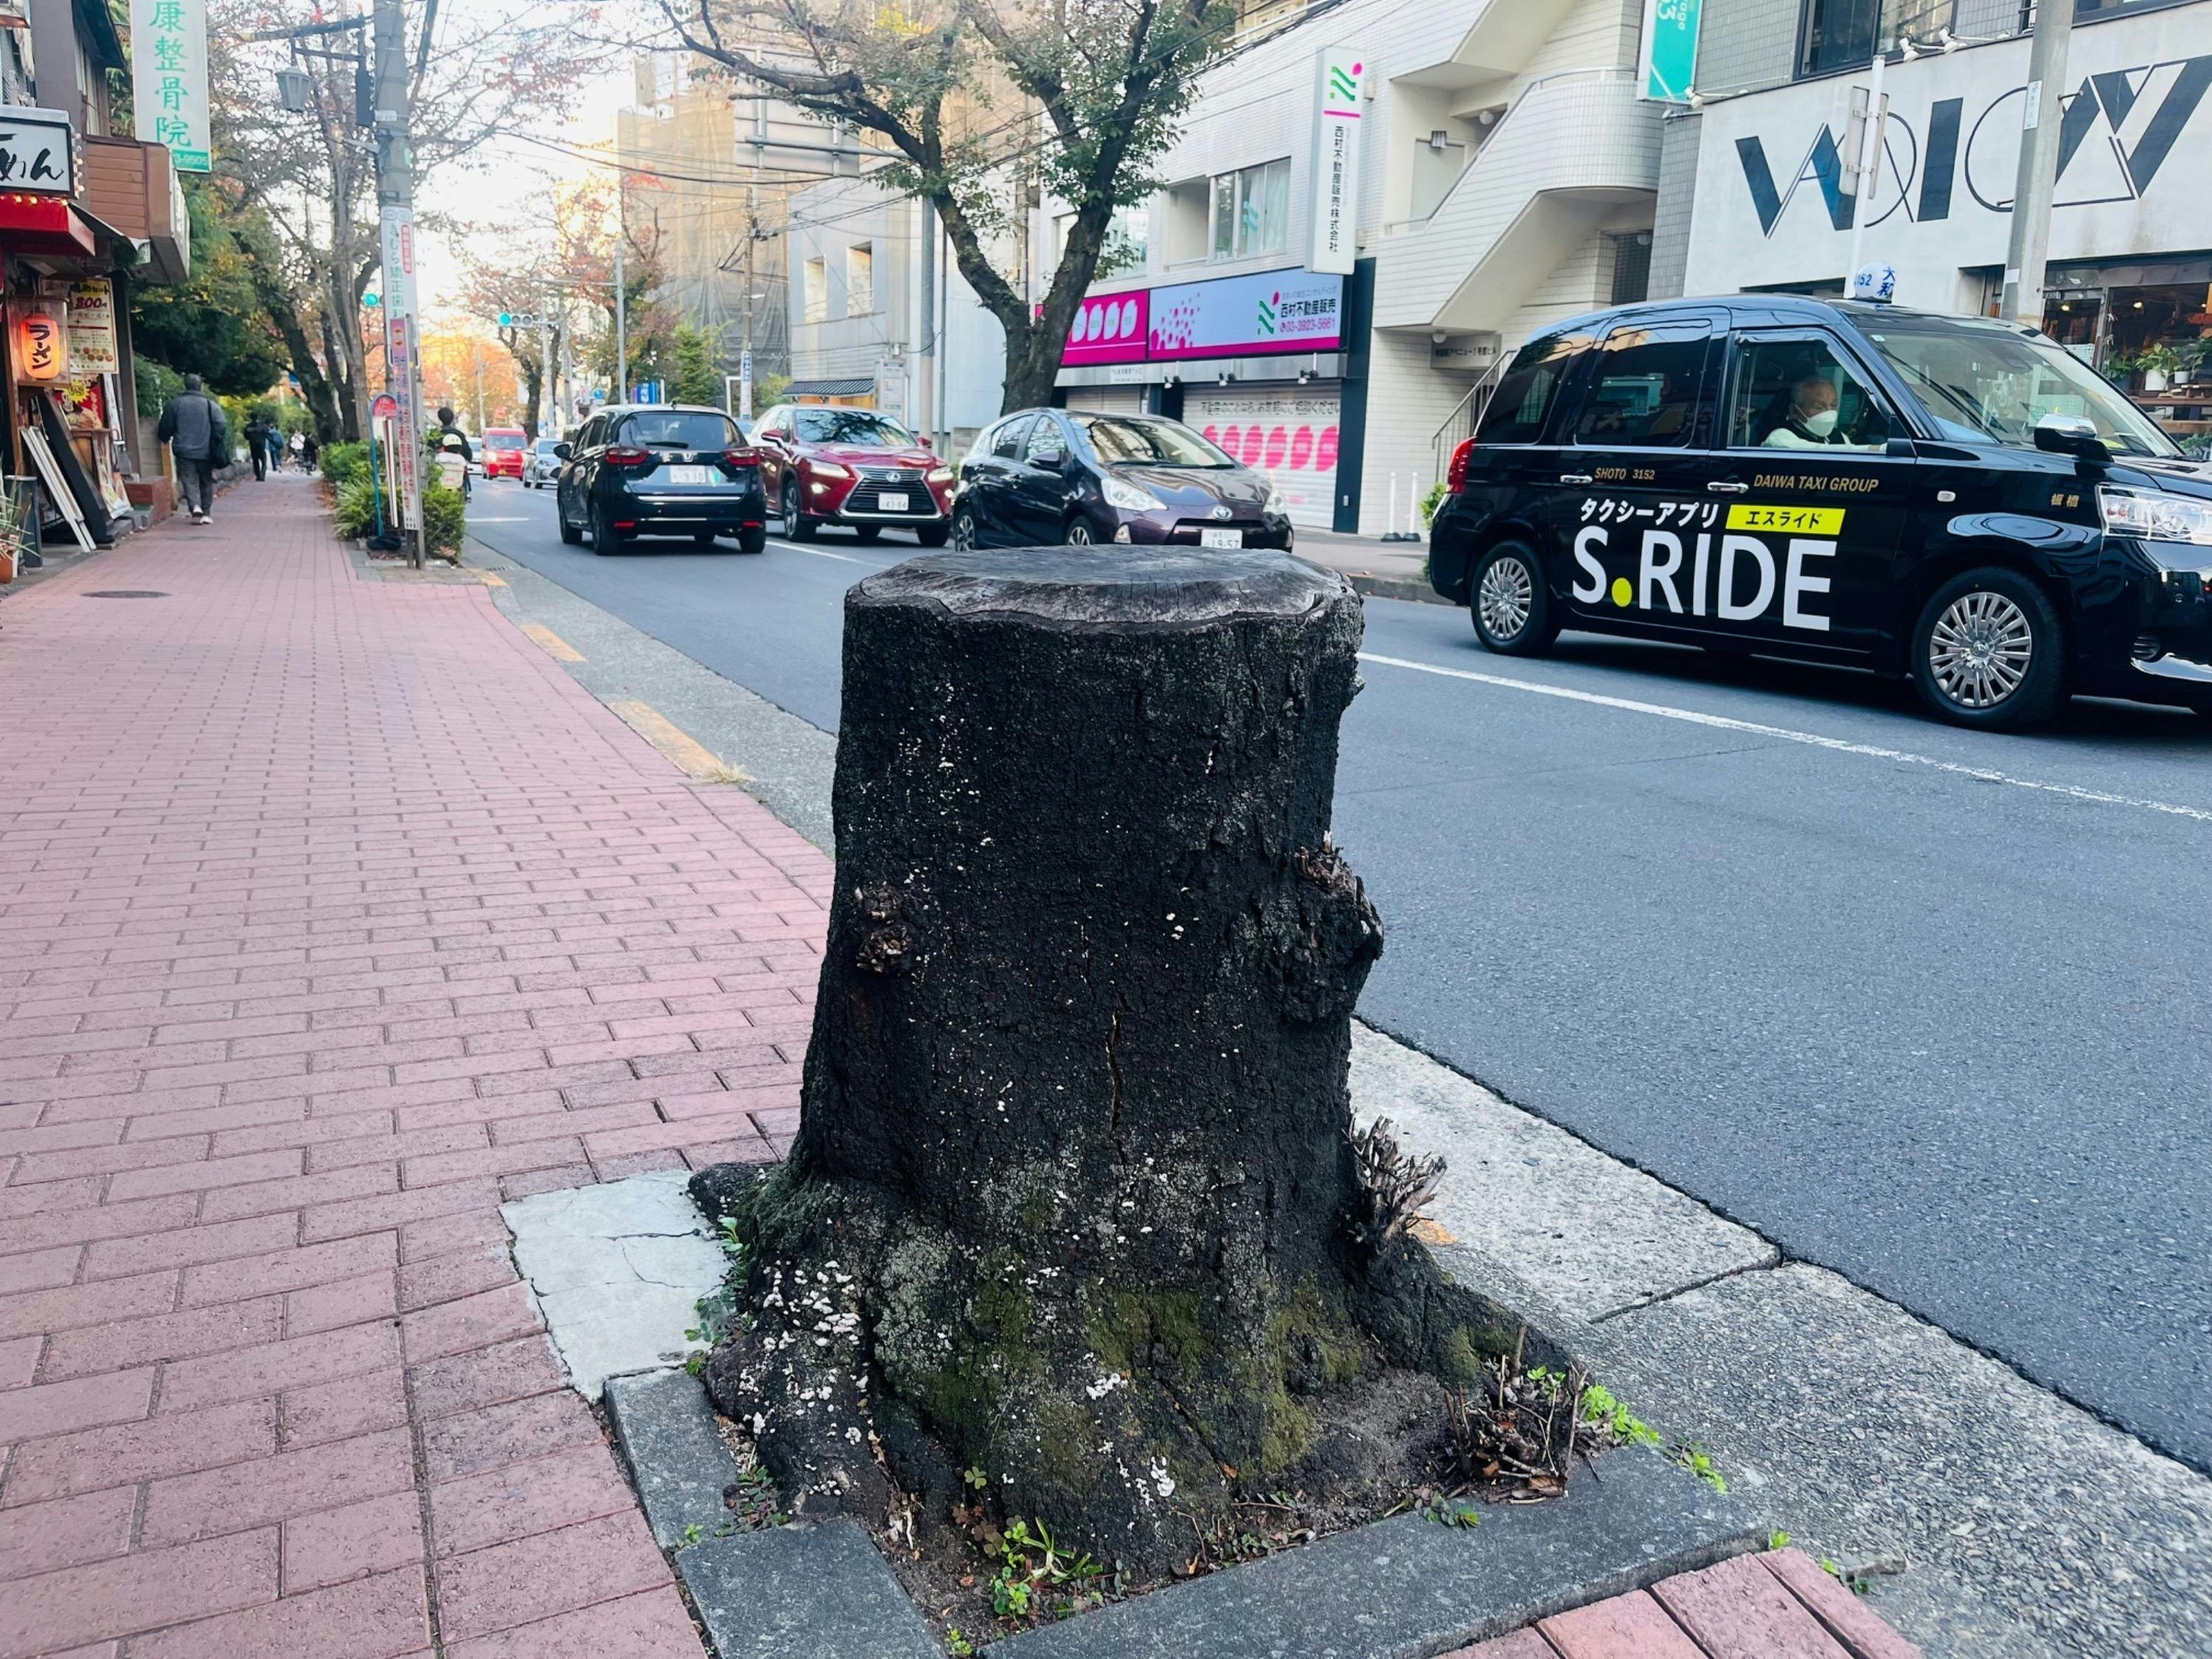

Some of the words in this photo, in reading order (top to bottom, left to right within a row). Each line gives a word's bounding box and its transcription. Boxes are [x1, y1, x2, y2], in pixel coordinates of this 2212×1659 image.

[149, 0, 192, 147] 康整骨院
[28, 324, 52, 369] ラーメン
[1595, 467, 1627, 479] SHOTO
[1632, 470, 1655, 480] 3152
[1753, 474, 1795, 489] DAIWA
[1798, 476, 1827, 490] TAXI
[1829, 477, 1879, 493] GROUP
[1580, 498, 1719, 529] タクシーアプリ
[1745, 511, 1822, 529] エスライド
[1572, 525, 1837, 632] S.RIDE
